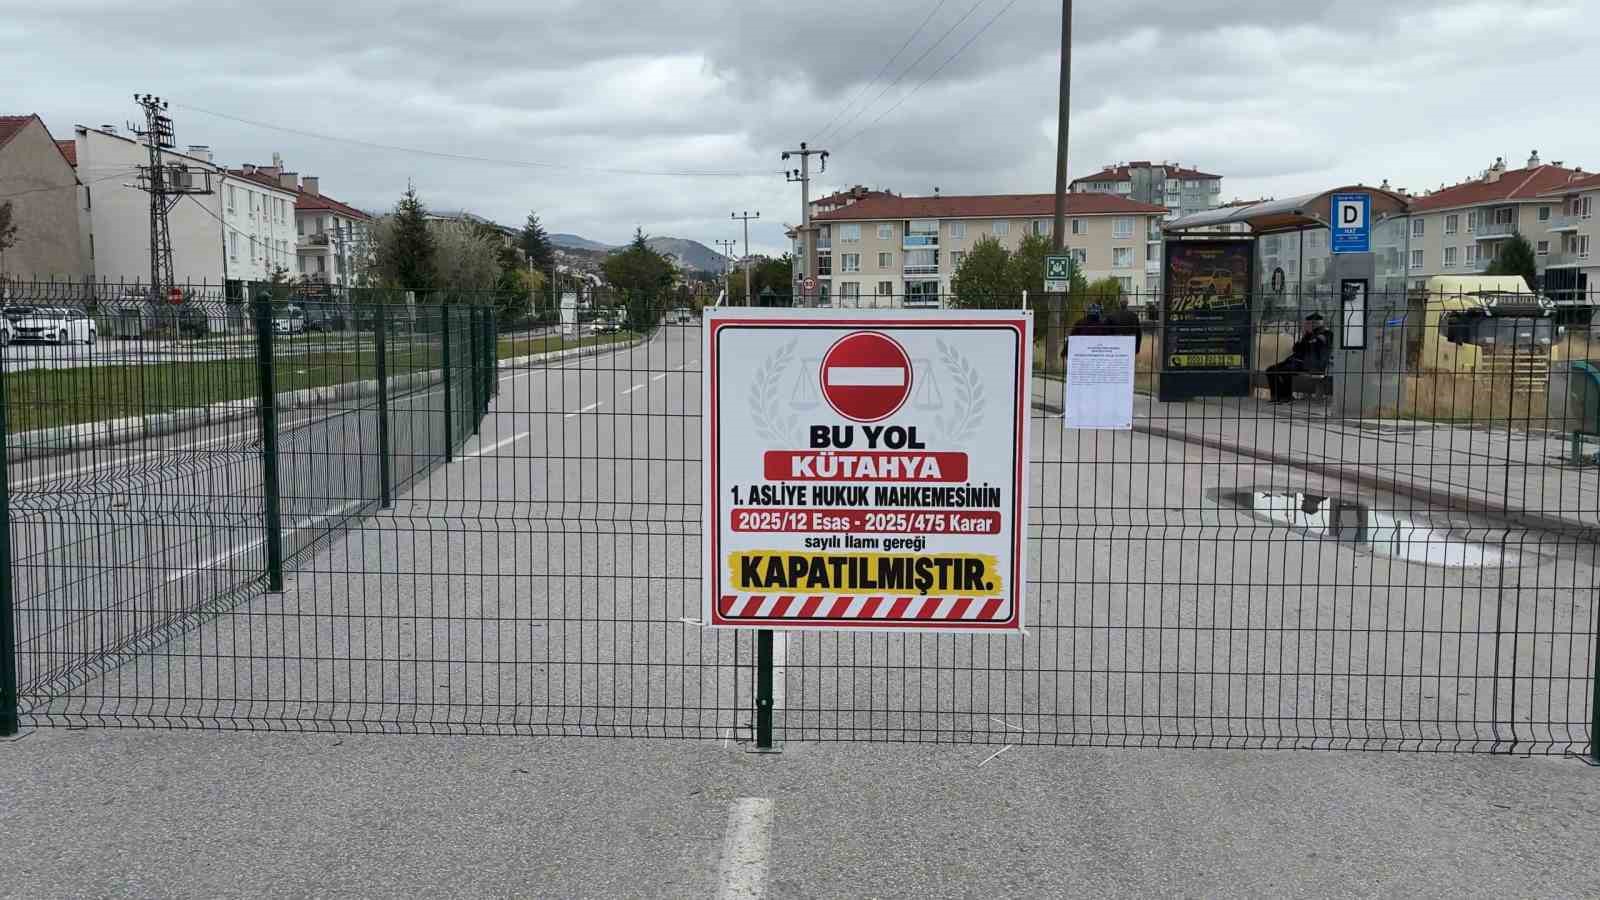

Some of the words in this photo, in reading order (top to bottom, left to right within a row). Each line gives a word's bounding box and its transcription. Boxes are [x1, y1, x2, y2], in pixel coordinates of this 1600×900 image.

[1343, 205, 1358, 223] D
[1171, 295, 1204, 311] 7/24
[810, 425, 854, 449] BU
[862, 425, 925, 449] YOL
[791, 452, 942, 479] KÜTAHYA
[731, 486, 744, 505] 1.
[749, 482, 807, 506] ASLİYE
[812, 486, 869, 507] HUKUK
[874, 482, 1001, 508] MAHKEMESİNİN
[739, 512, 807, 531] 2025/12
[813, 512, 850, 531] Esas
[865, 513, 944, 532] 2025/475
[950, 514, 993, 532] Karar
[804, 534, 841, 550] sayılı
[845, 533, 879, 549] İlamı
[883, 536, 926, 551] gereği
[740, 555, 994, 595] KAPATILMIŞTIR.
